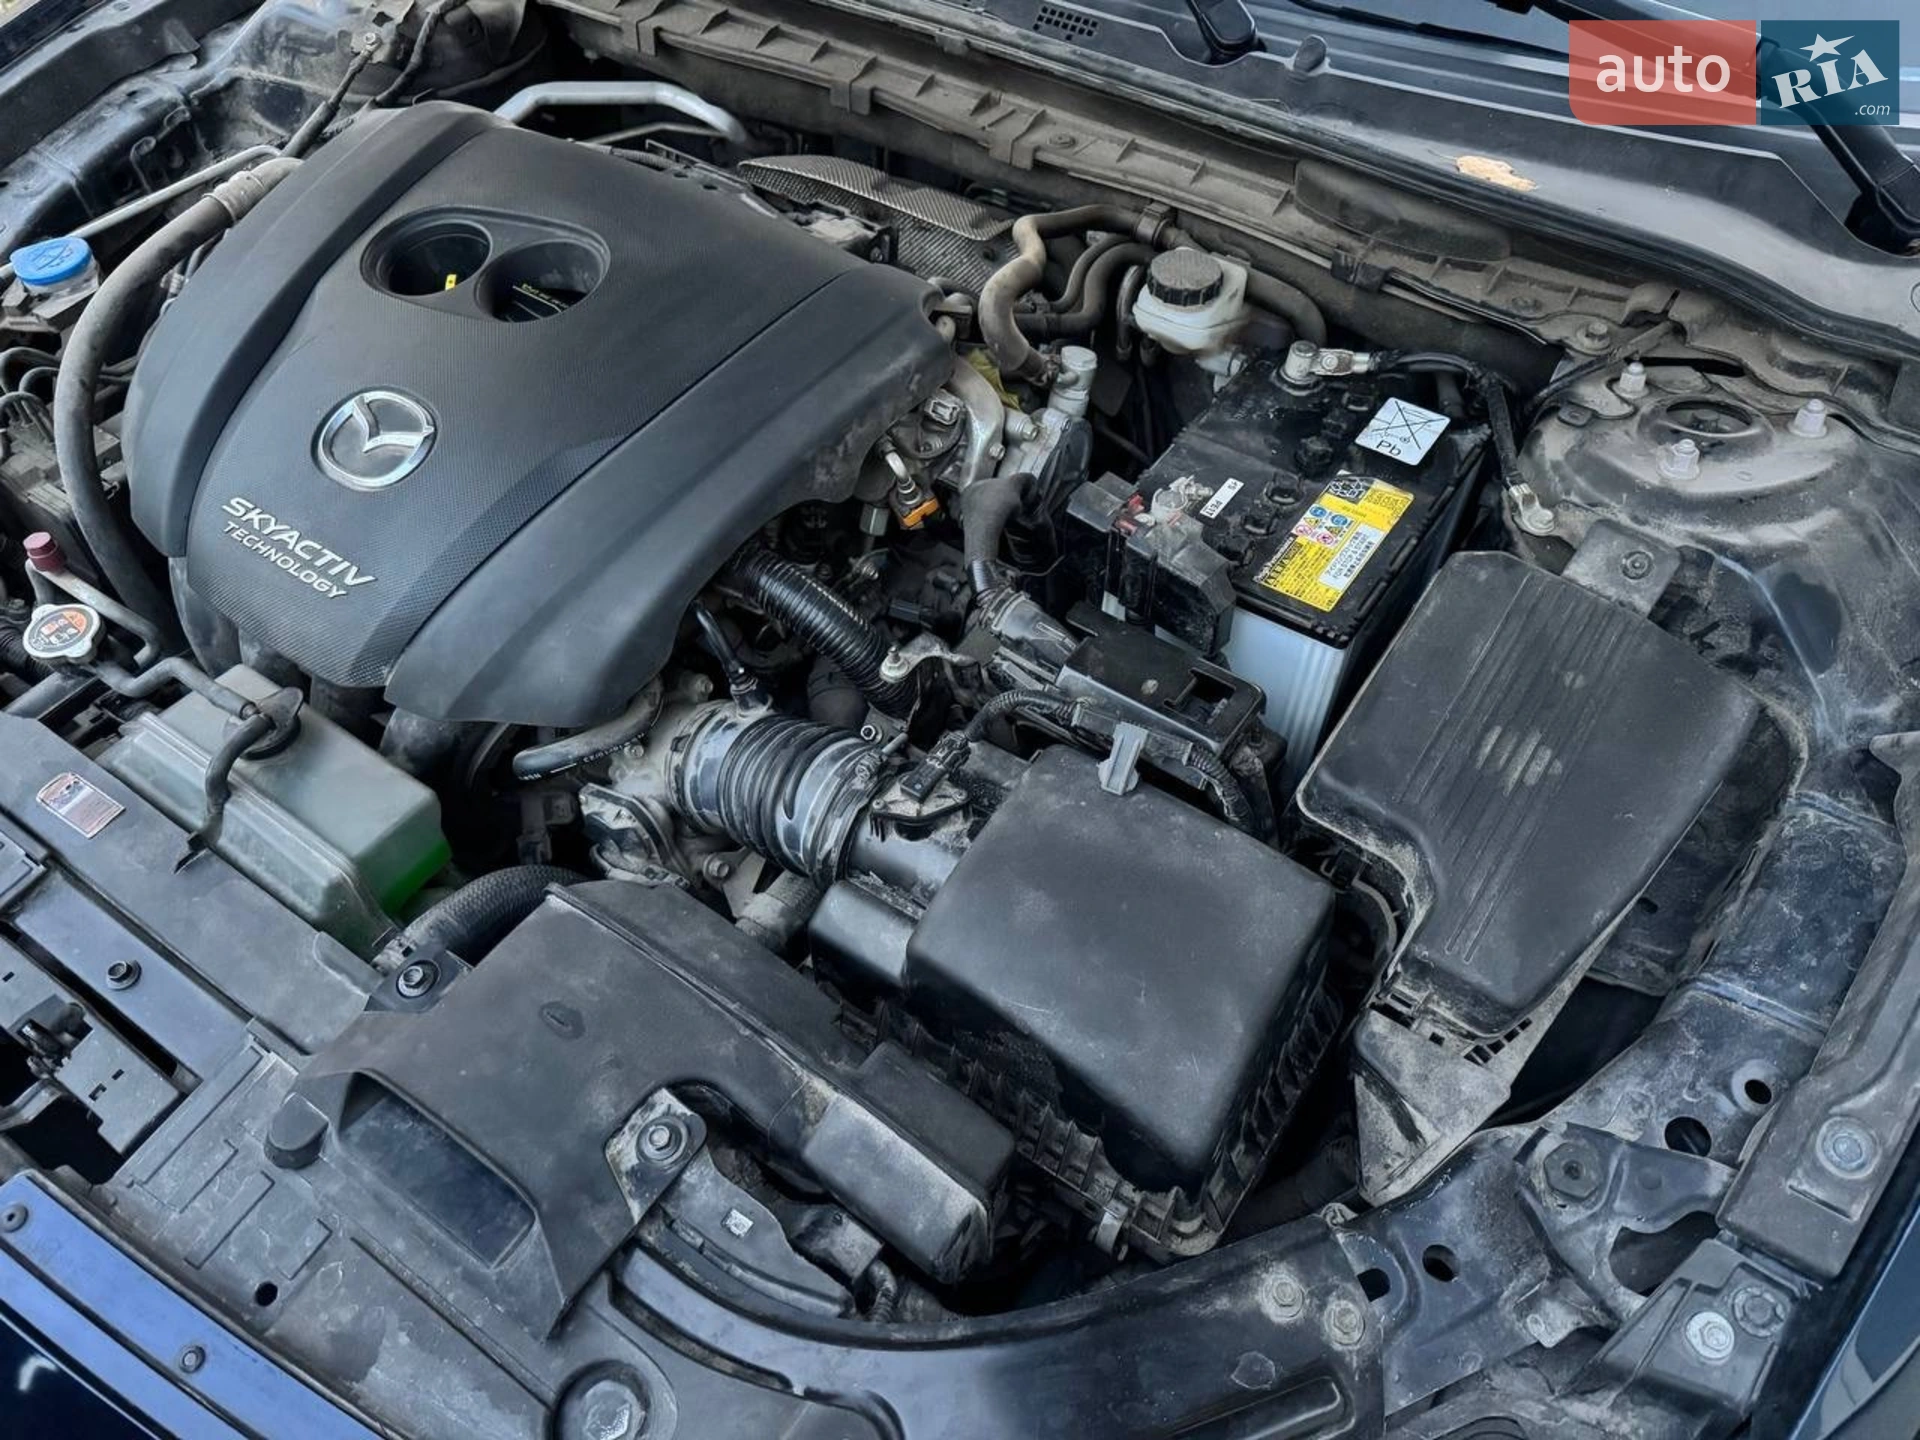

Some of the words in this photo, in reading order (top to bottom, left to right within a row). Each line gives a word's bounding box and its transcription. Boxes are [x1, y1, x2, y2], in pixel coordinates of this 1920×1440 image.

[1376, 440, 1402, 456] Pb
[222, 496, 377, 587] SKYACTIV
[223, 520, 348, 599] TECHNOLOGY
